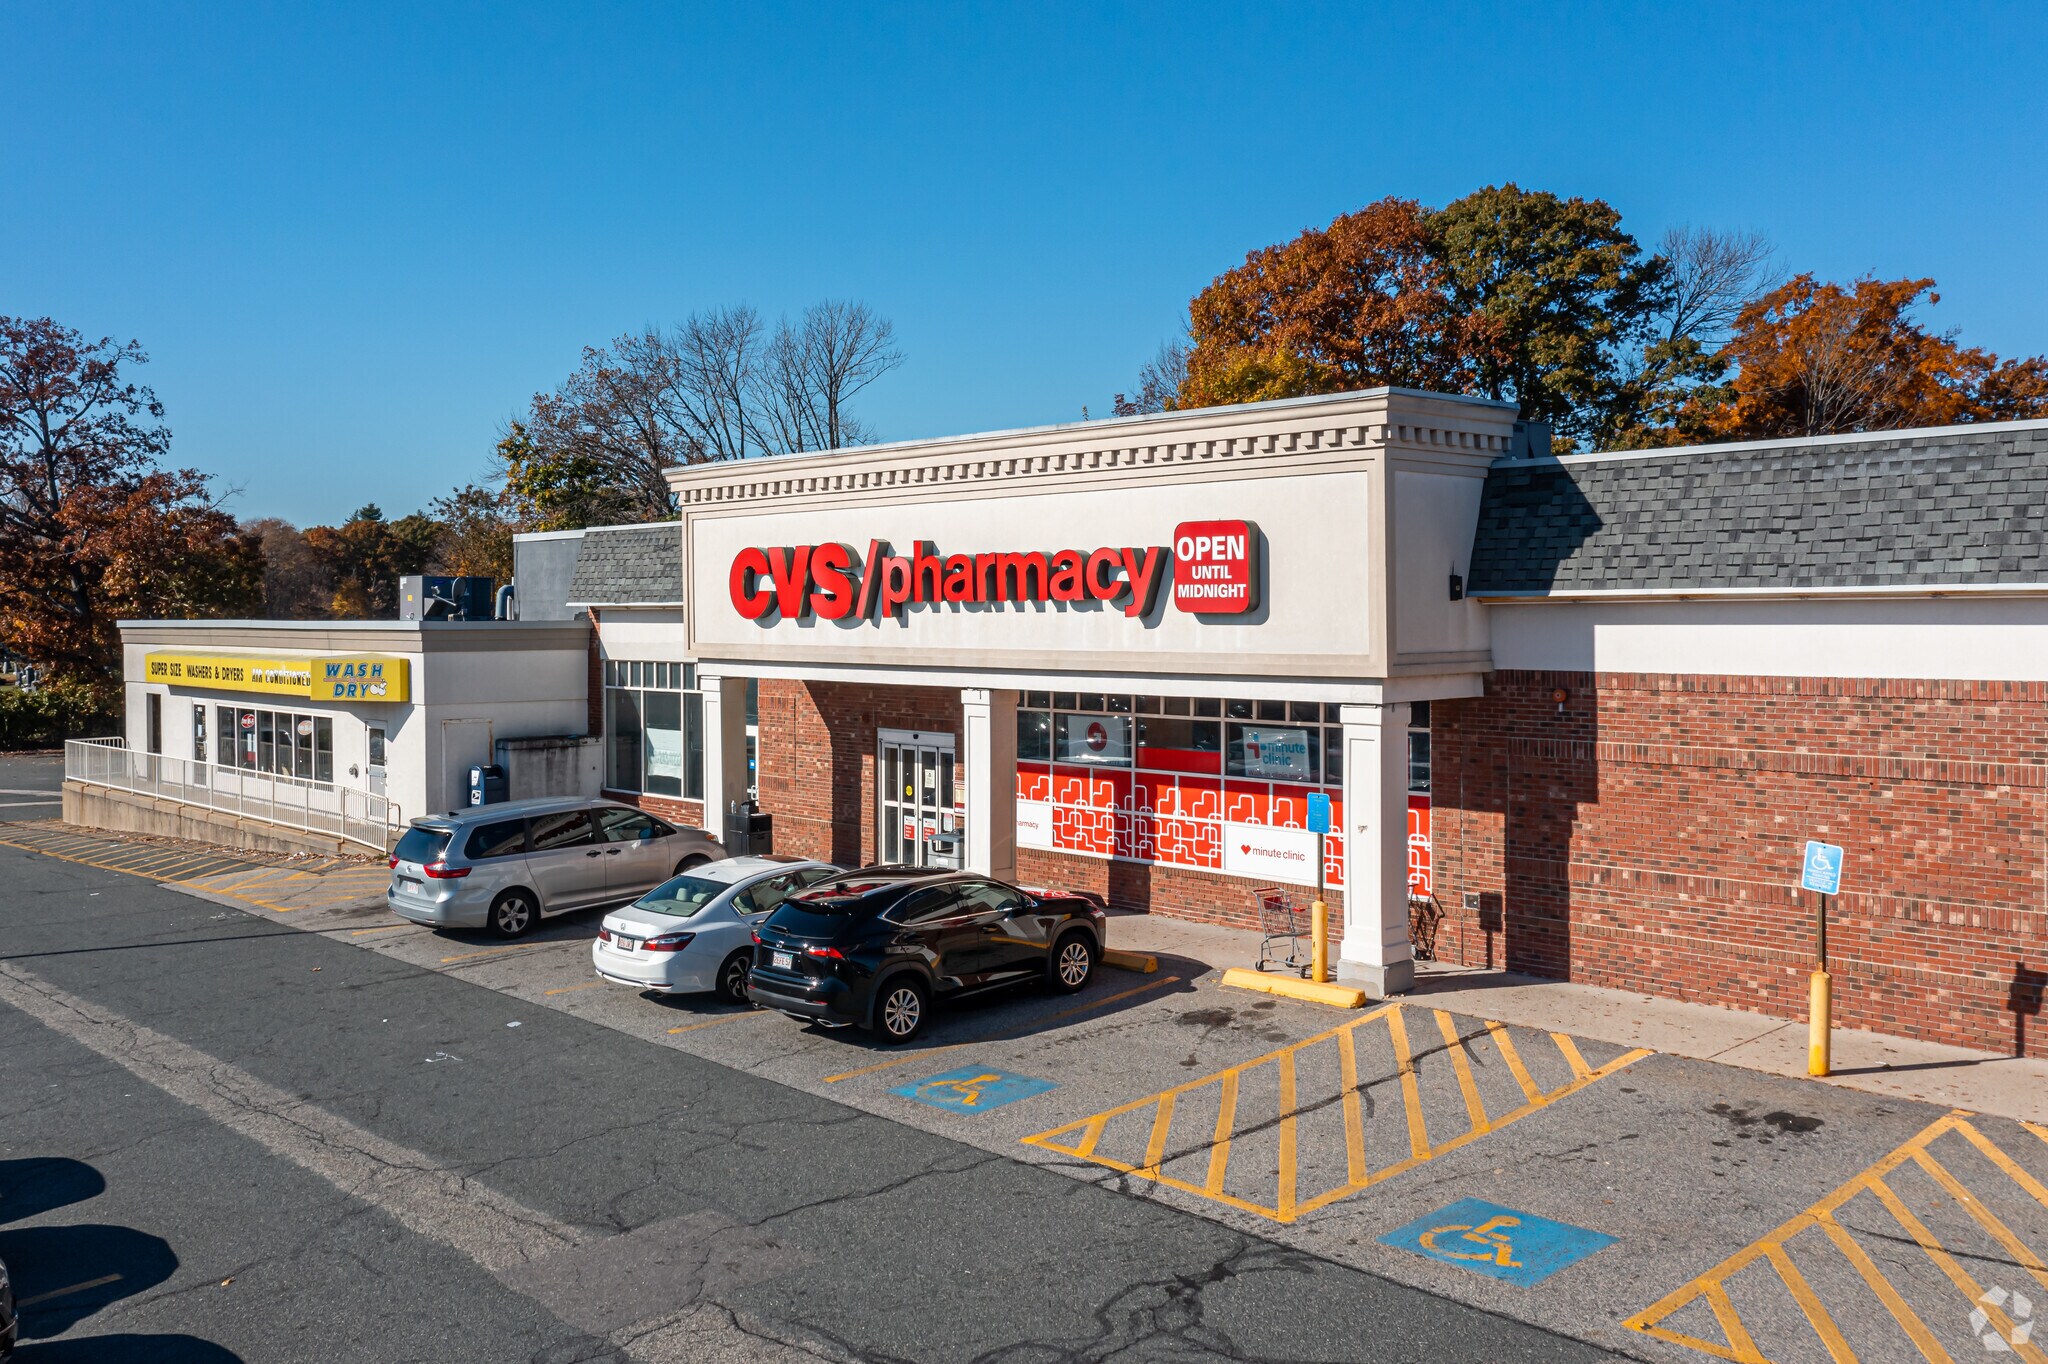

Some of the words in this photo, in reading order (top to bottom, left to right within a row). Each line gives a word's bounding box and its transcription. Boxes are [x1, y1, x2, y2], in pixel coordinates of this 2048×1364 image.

[1177, 535, 1244, 561] OPEN
[729, 538, 1160, 619] CVS/pharmacy
[1192, 565, 1232, 579] UNTIL
[1178, 583, 1247, 598] MIDNIGHT
[151, 661, 168, 676] SUPER
[170, 663, 182, 677] SIZE
[187, 664, 212, 679] WASHERS
[215, 666, 219, 680] &
[222, 667, 244, 682] DRYERS
[252, 668, 263, 683] AIR
[265, 669, 311, 687] CONDITIONED
[325, 663, 384, 677] WASH
[333, 683, 369, 698] DRY
[1267, 739, 1306, 754] minute
[1263, 752, 1291, 766] clinic
[1252, 846, 1282, 859] minute
[1282, 849, 1306, 862] clinic
